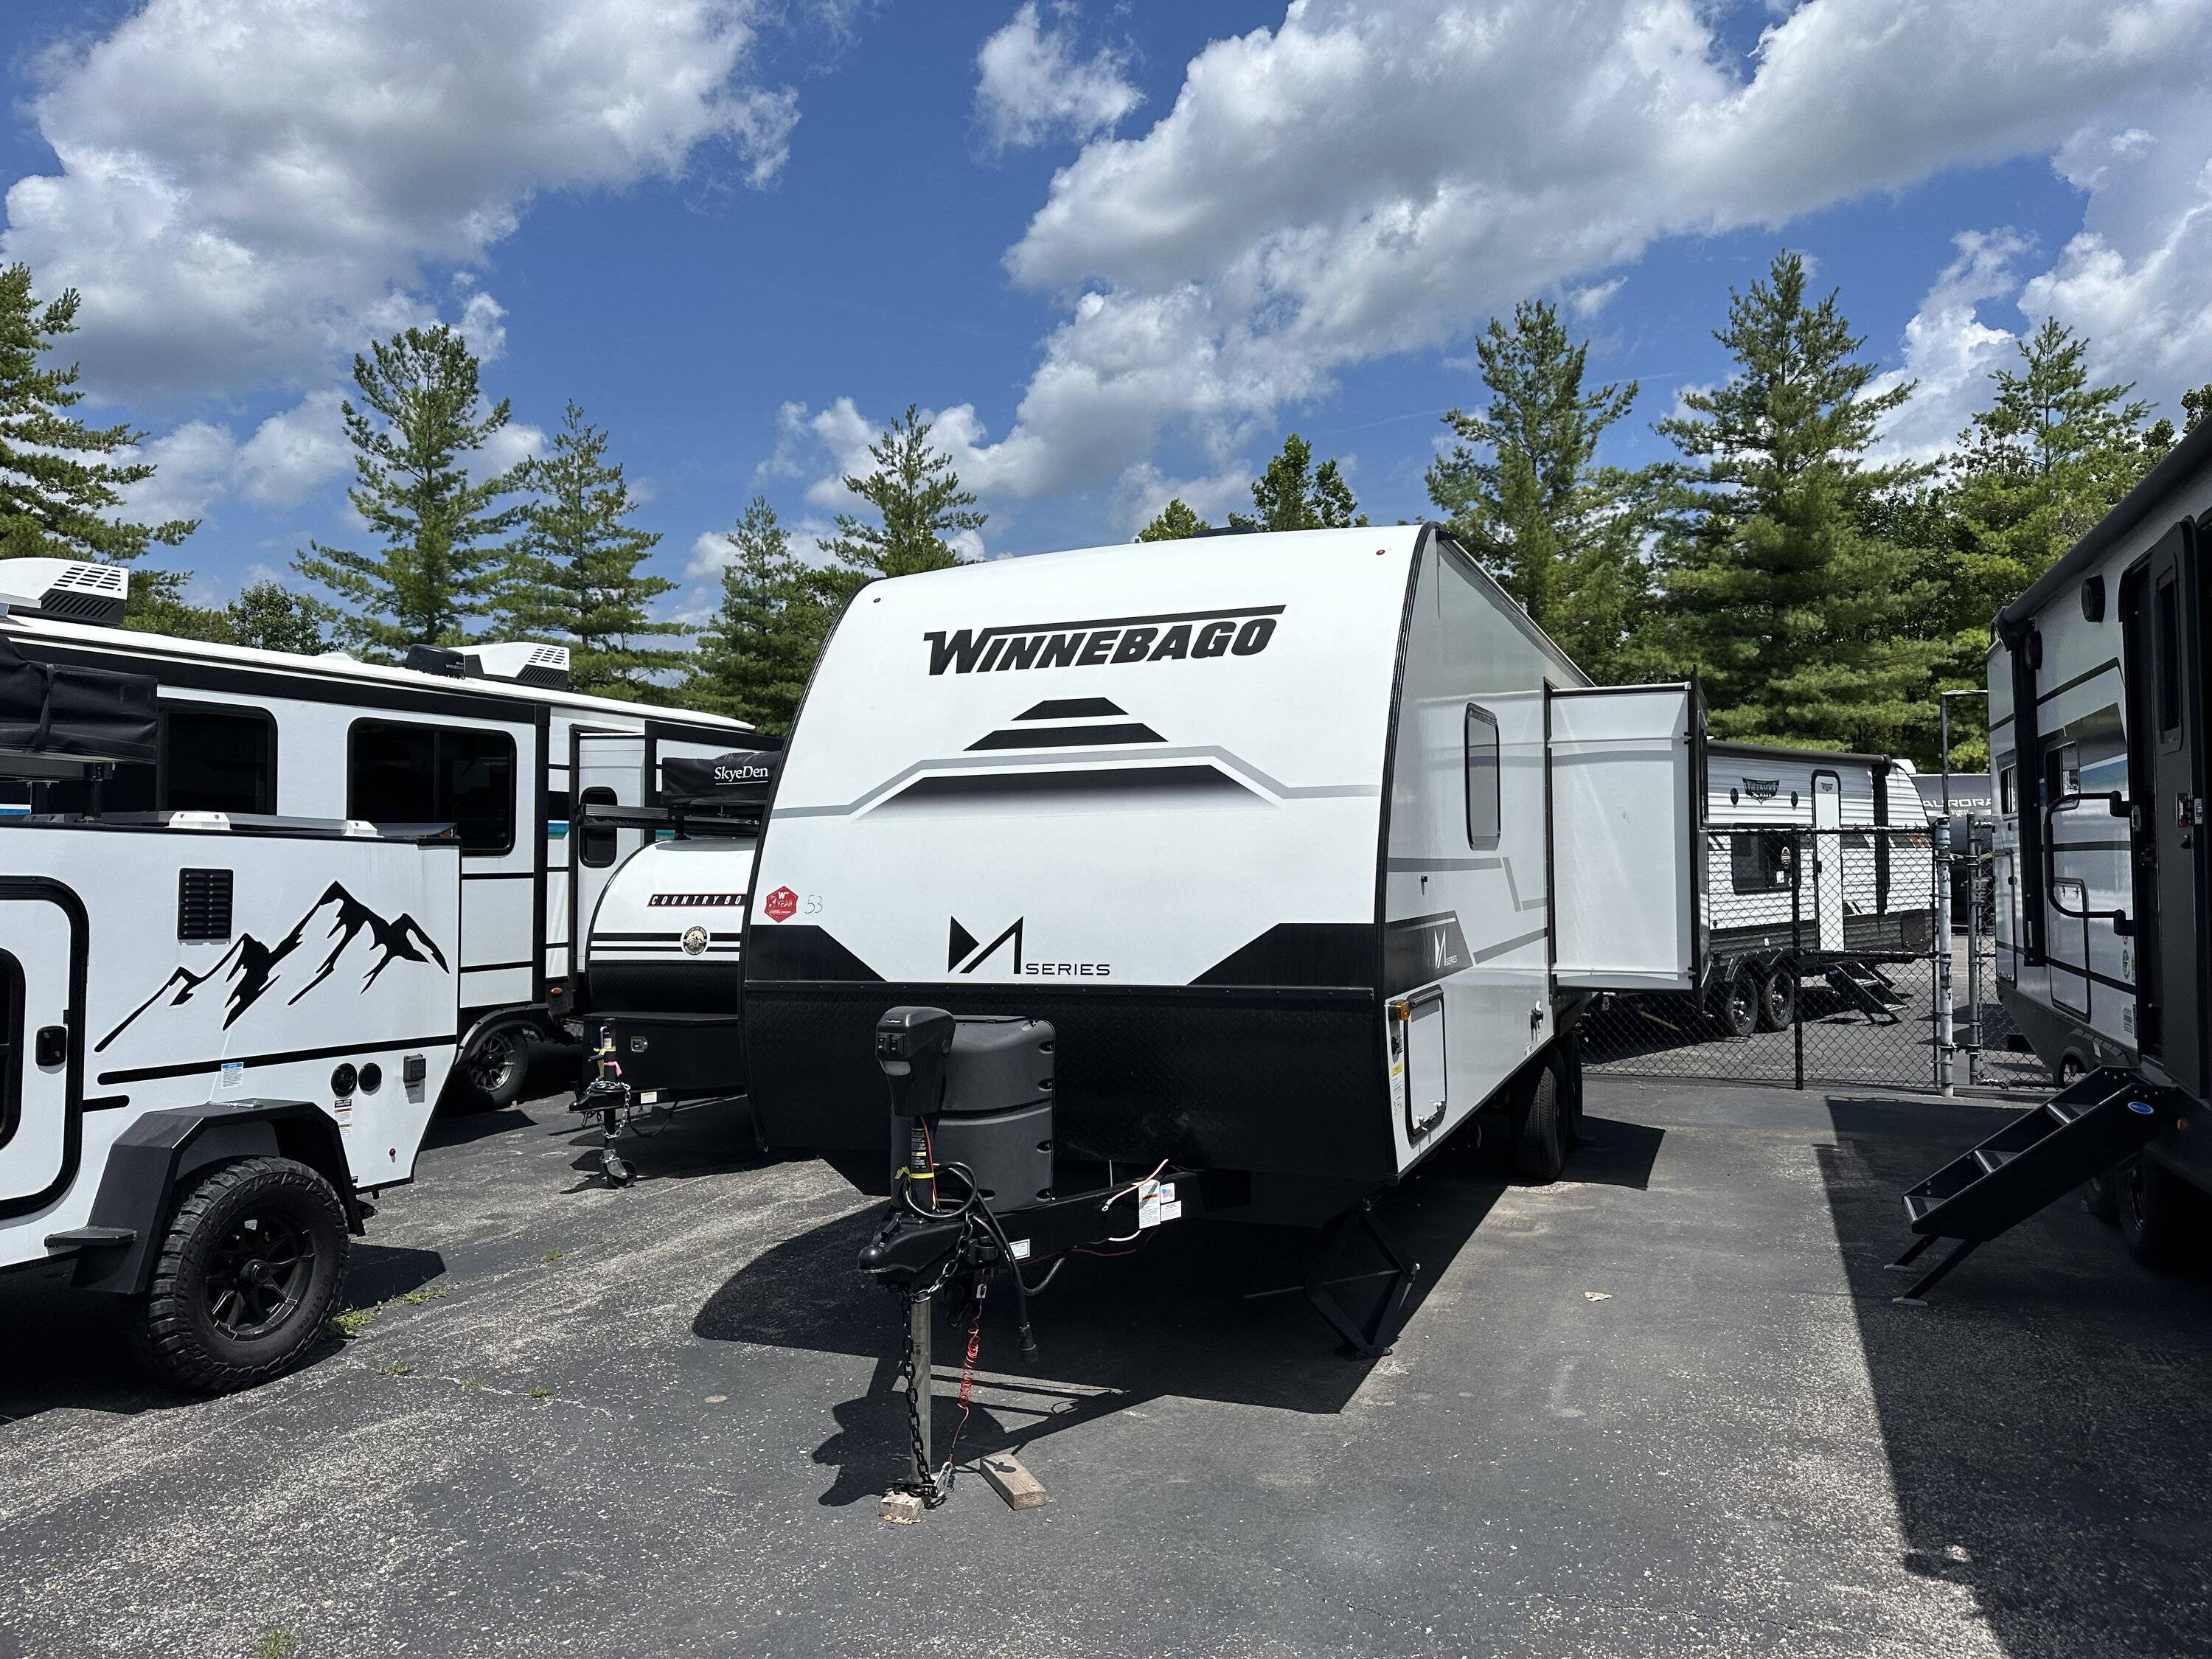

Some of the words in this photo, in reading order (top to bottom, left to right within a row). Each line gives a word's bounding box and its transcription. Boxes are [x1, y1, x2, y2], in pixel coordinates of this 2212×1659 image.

[923, 605, 1287, 675] WINNEBAGO
[714, 765, 769, 782] SkyeDen
[651, 895, 719, 905] COUNTRY
[804, 894, 823, 914] 53
[1026, 963, 1110, 975] SERIES
